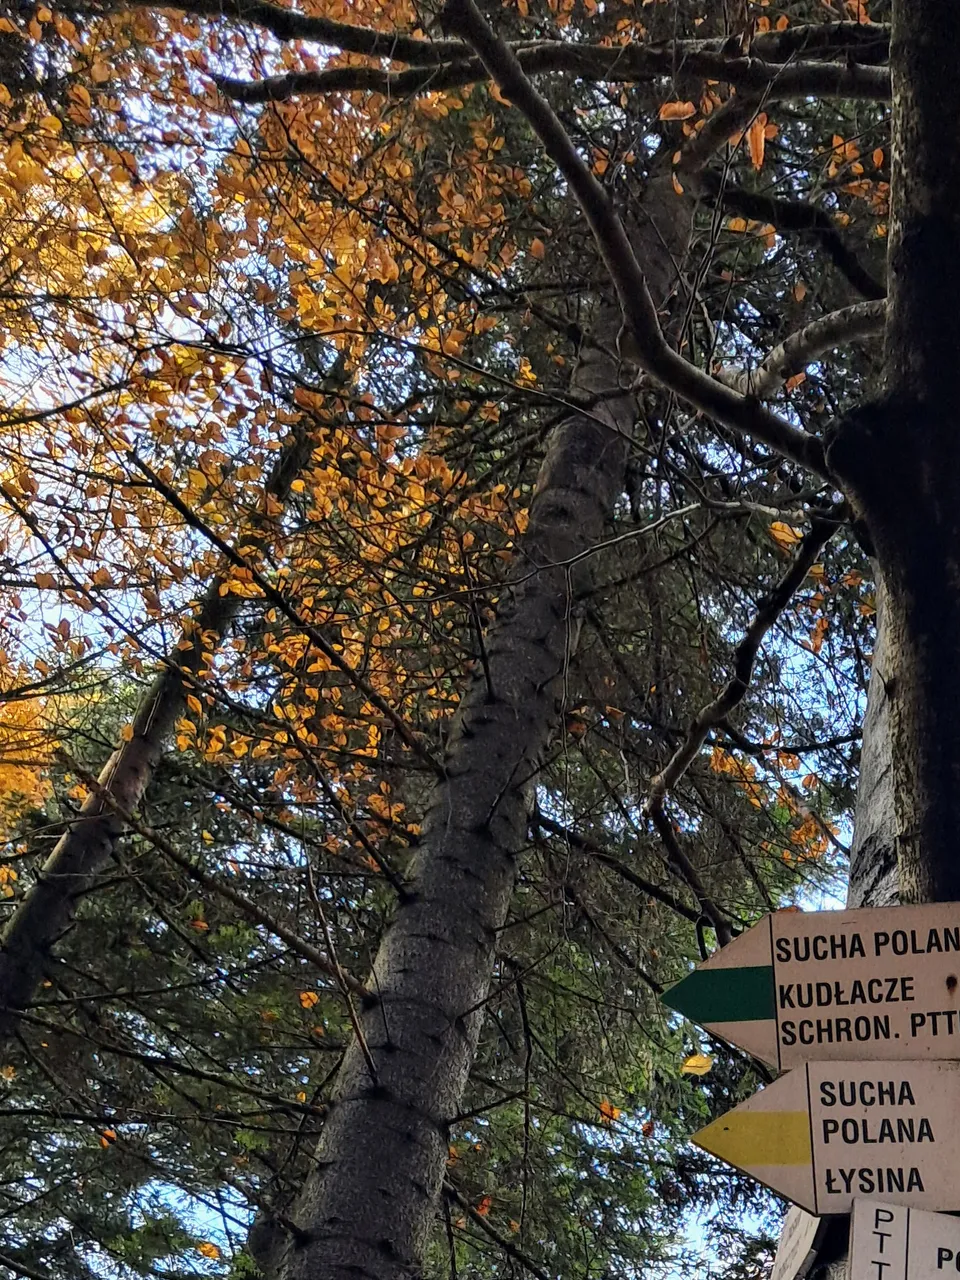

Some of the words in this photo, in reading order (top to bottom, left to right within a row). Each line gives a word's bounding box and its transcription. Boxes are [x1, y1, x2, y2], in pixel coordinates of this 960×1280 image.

[776, 933, 865, 963] SUCHA
[779, 976, 915, 1010] KUDŁACZE
[781, 1017, 900, 1047] SCHRON.
[819, 1080, 916, 1107] SUCHA
[823, 1118, 935, 1145] POLANA
[825, 1167, 925, 1195] ŁYSINA
